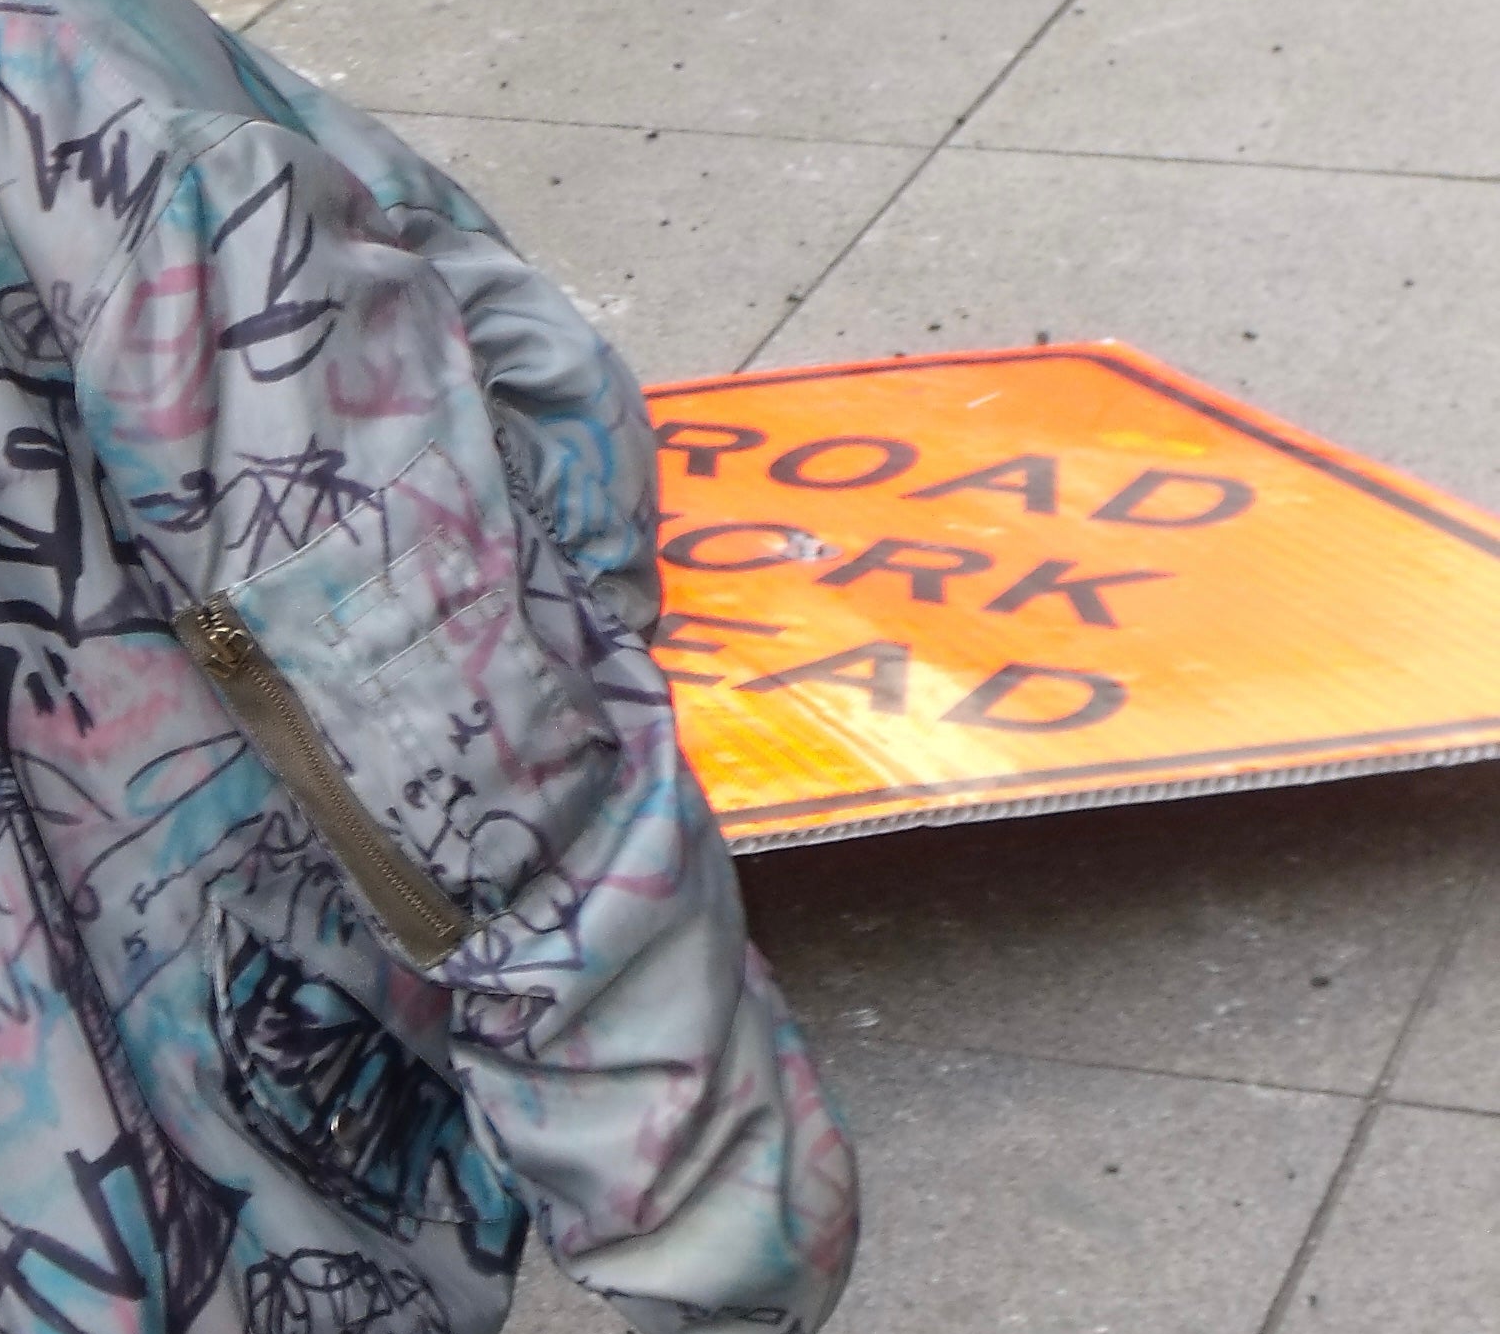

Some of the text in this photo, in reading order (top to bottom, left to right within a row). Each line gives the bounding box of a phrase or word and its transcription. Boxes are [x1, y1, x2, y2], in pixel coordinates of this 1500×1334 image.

[656, 421, 1257, 529] ROAD
[658, 511, 1176, 629] ORK
[655, 612, 1130, 733] EAD
